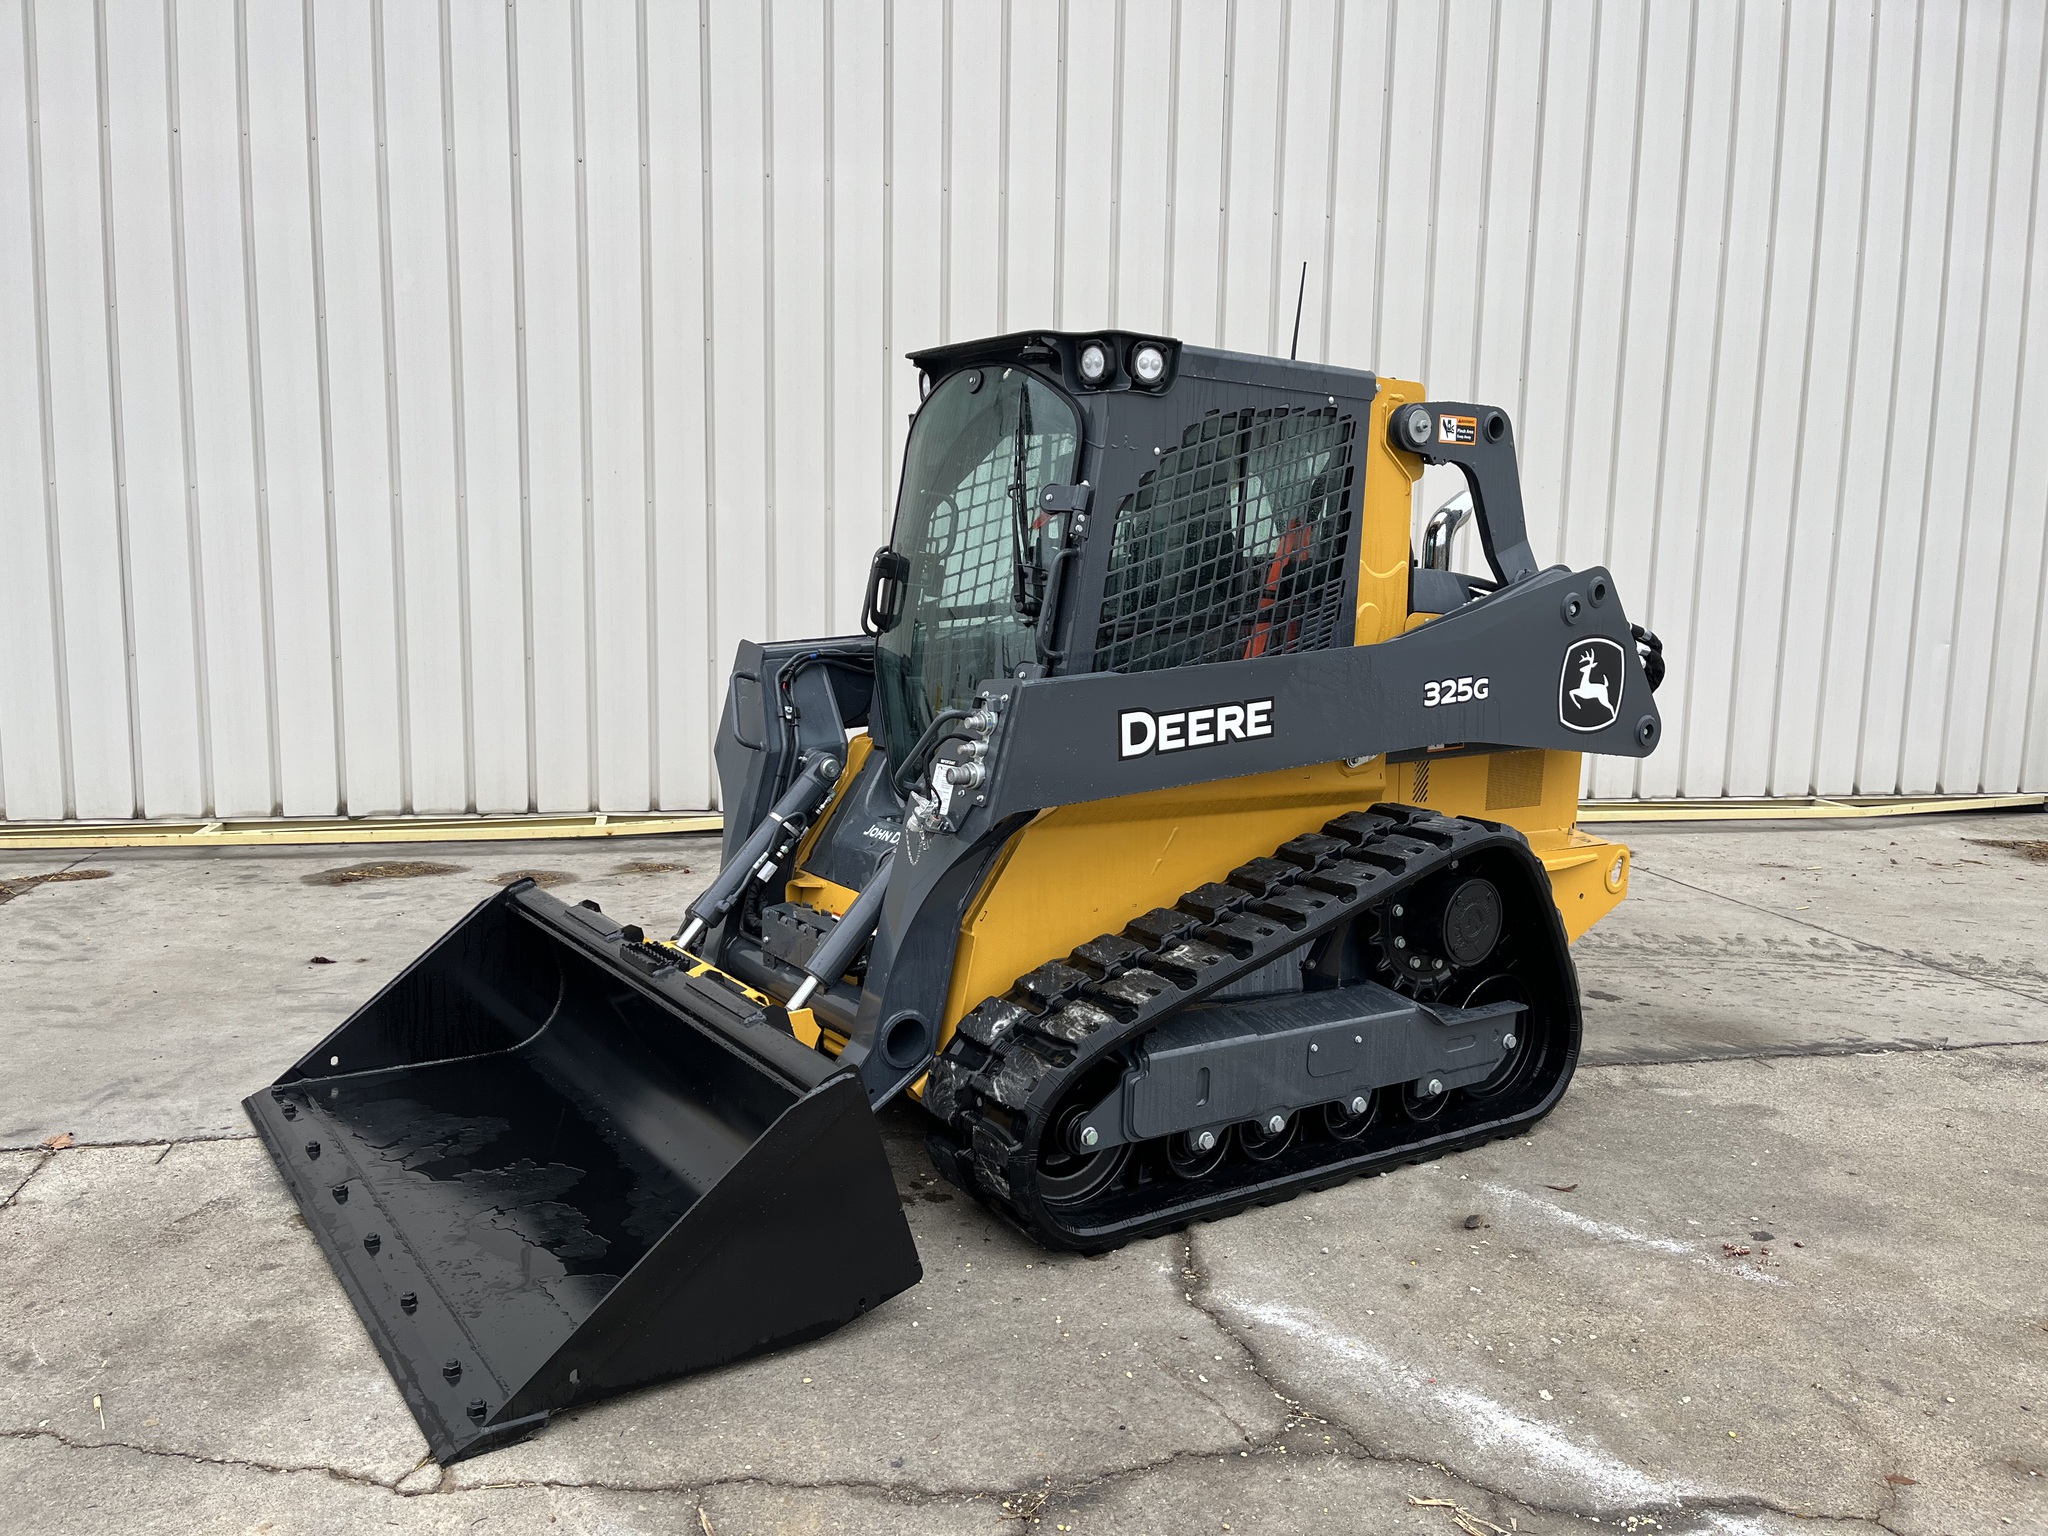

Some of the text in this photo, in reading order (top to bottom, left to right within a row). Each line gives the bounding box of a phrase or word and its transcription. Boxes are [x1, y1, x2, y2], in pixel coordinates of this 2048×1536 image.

[1424, 676, 1489, 706] 325G
[1121, 700, 1272, 757] DEERE
[863, 824, 901, 845] JOHN D
